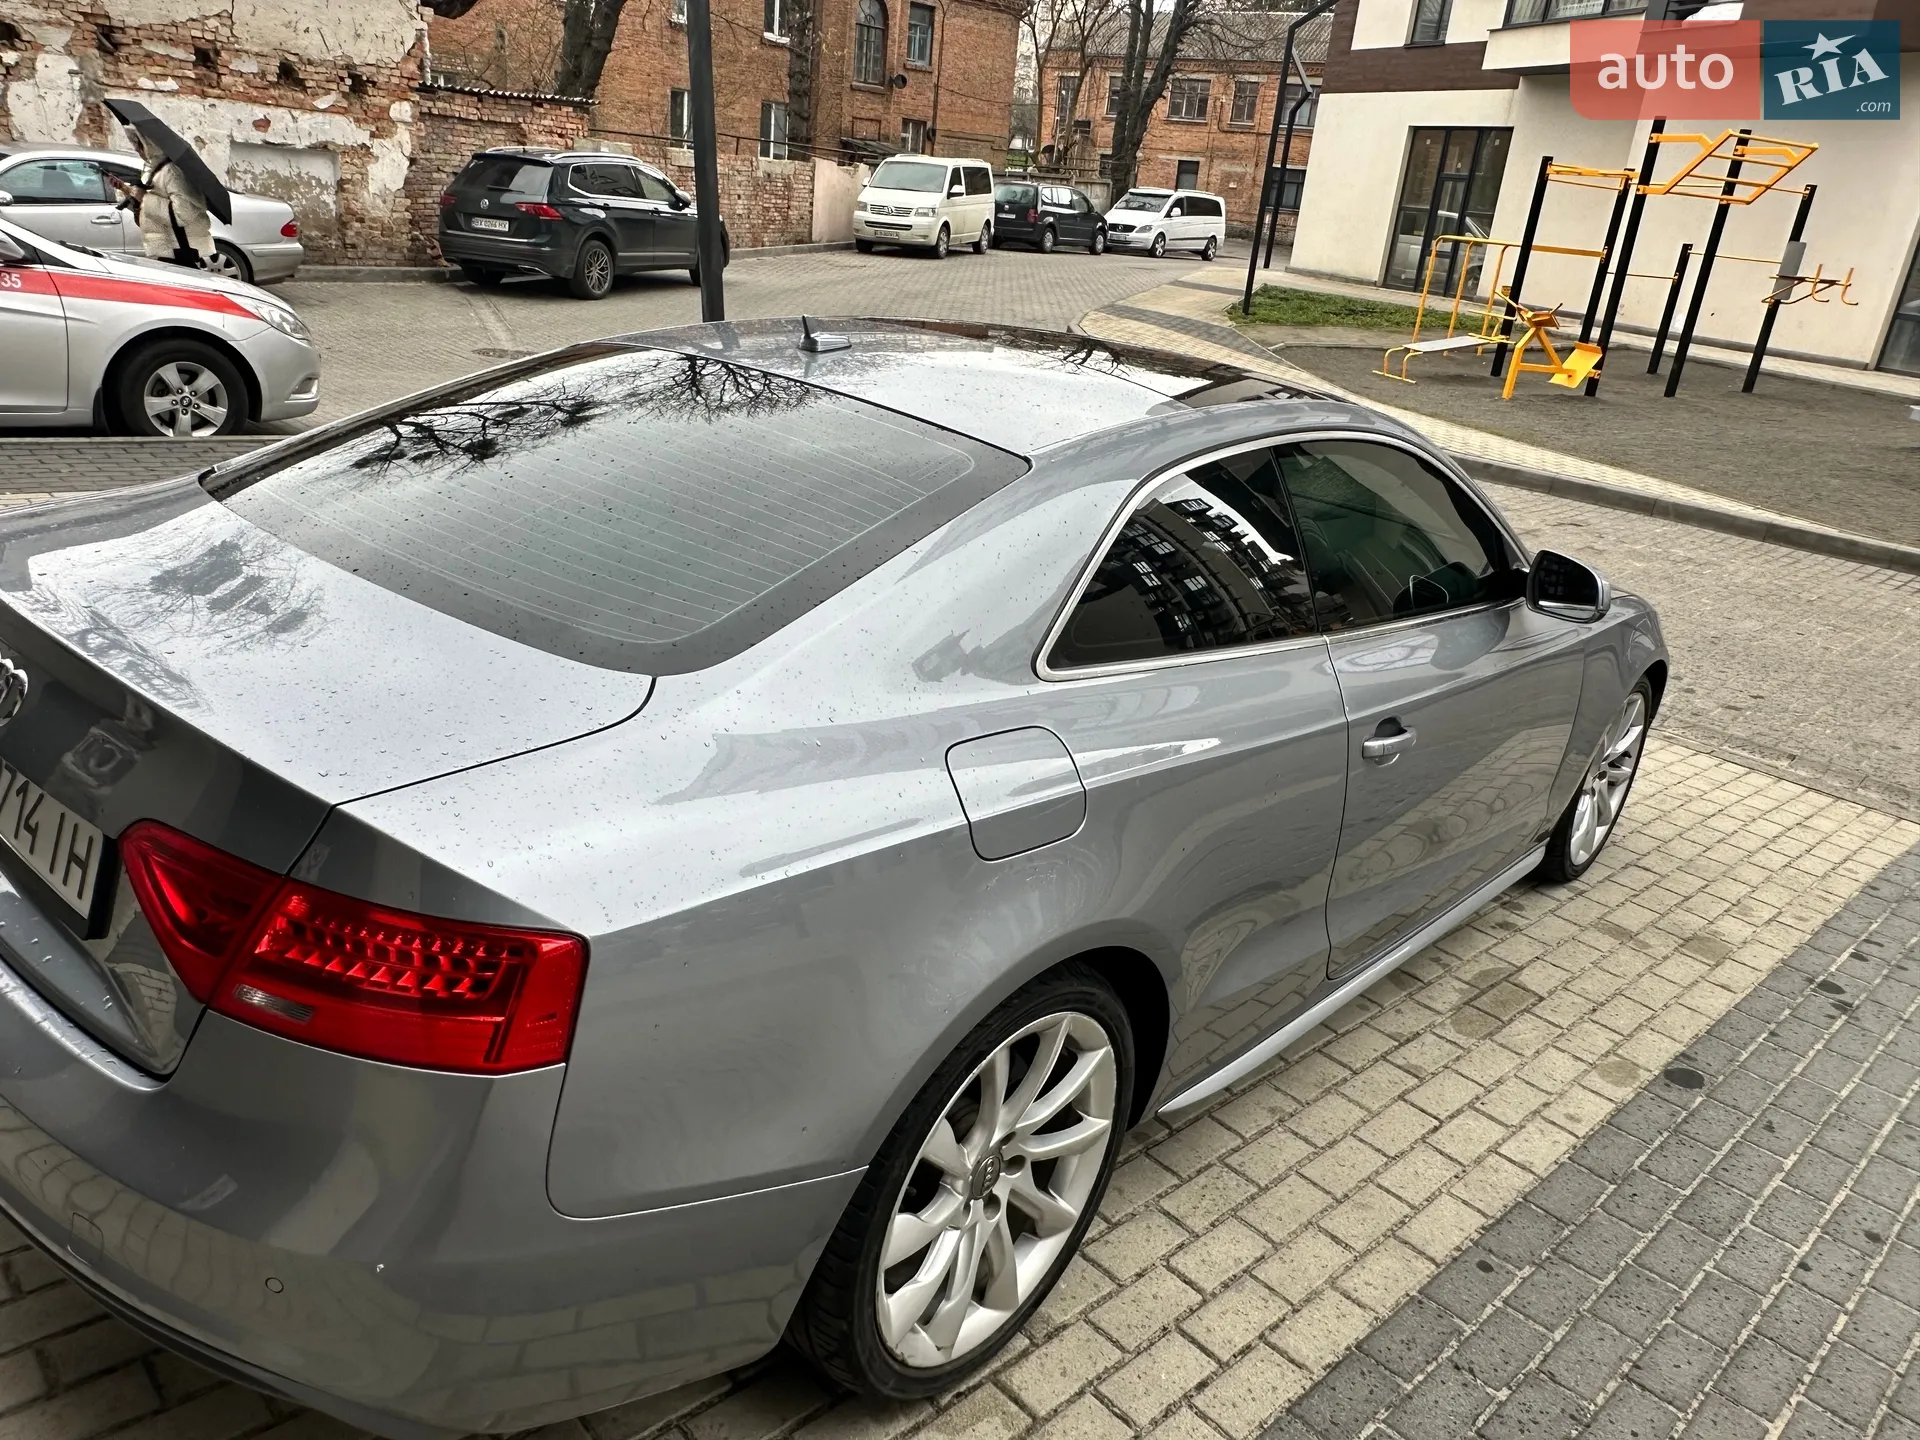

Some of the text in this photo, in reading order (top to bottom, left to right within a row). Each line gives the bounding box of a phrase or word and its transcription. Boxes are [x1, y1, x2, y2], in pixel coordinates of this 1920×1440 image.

[1, 272, 22, 289] 35
[0, 757, 93, 900] 714 IH
